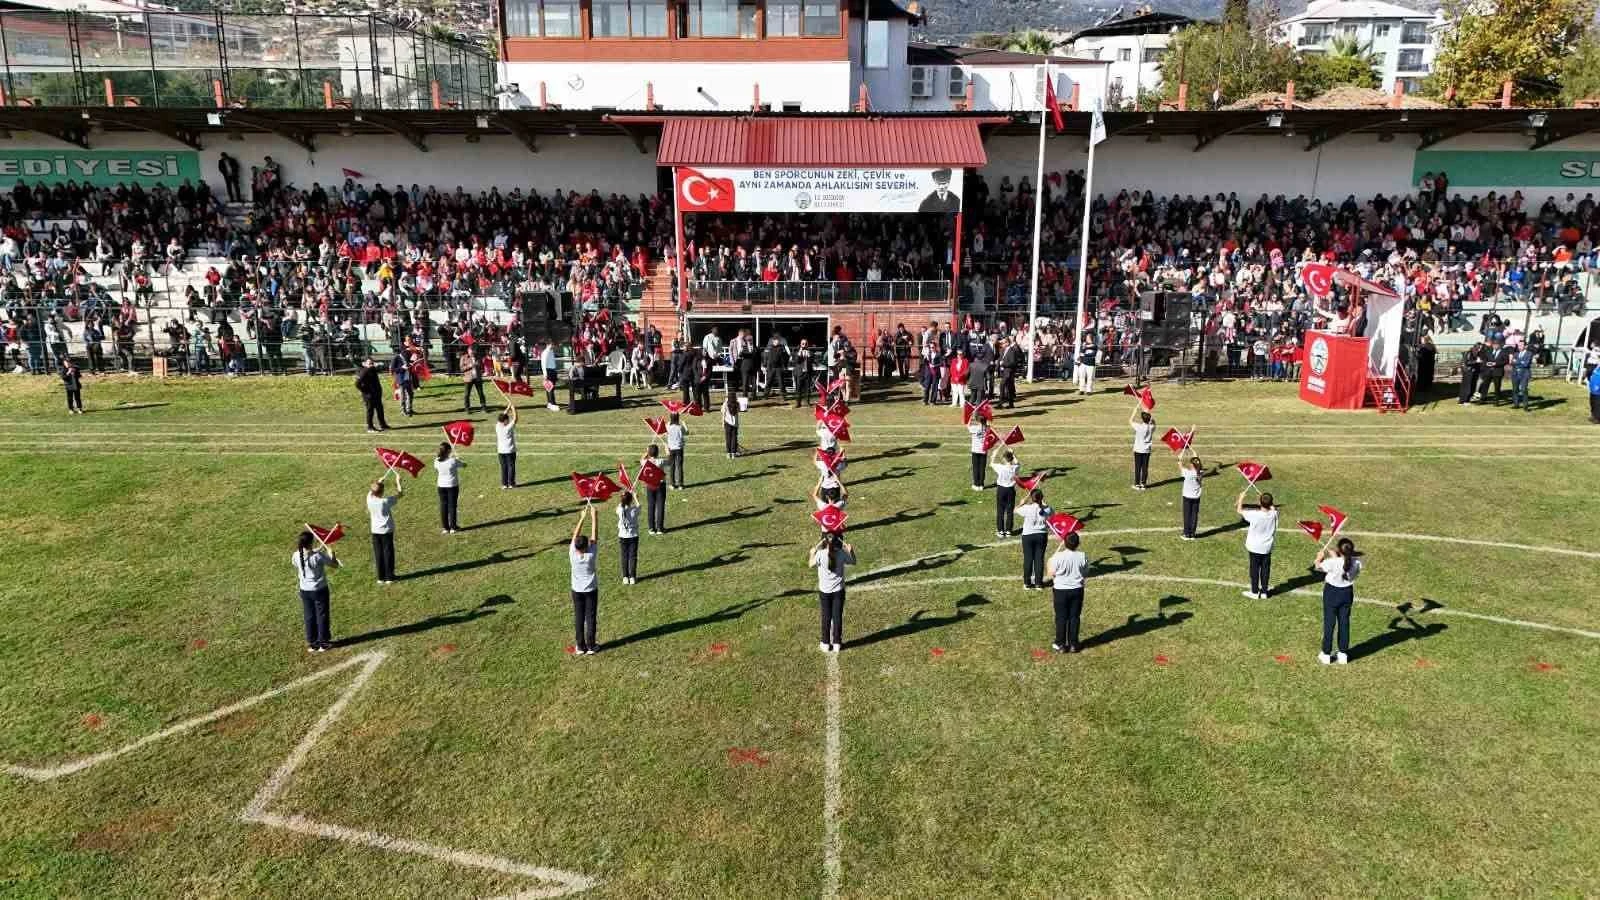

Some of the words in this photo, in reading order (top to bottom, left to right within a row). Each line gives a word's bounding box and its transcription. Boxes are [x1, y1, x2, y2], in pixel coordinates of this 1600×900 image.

[753, 170, 772, 179] BEN
[774, 170, 834, 179] SPORCUNUN
[836, 168, 860, 180] ZEKİ,
[862, 168, 891, 181] ÇEVİK
[893, 171, 905, 179] ve
[739, 180, 761, 189] AYNI
[764, 180, 812, 189] ZAMANDA
[875, 180, 919, 190] SEVERİM.
